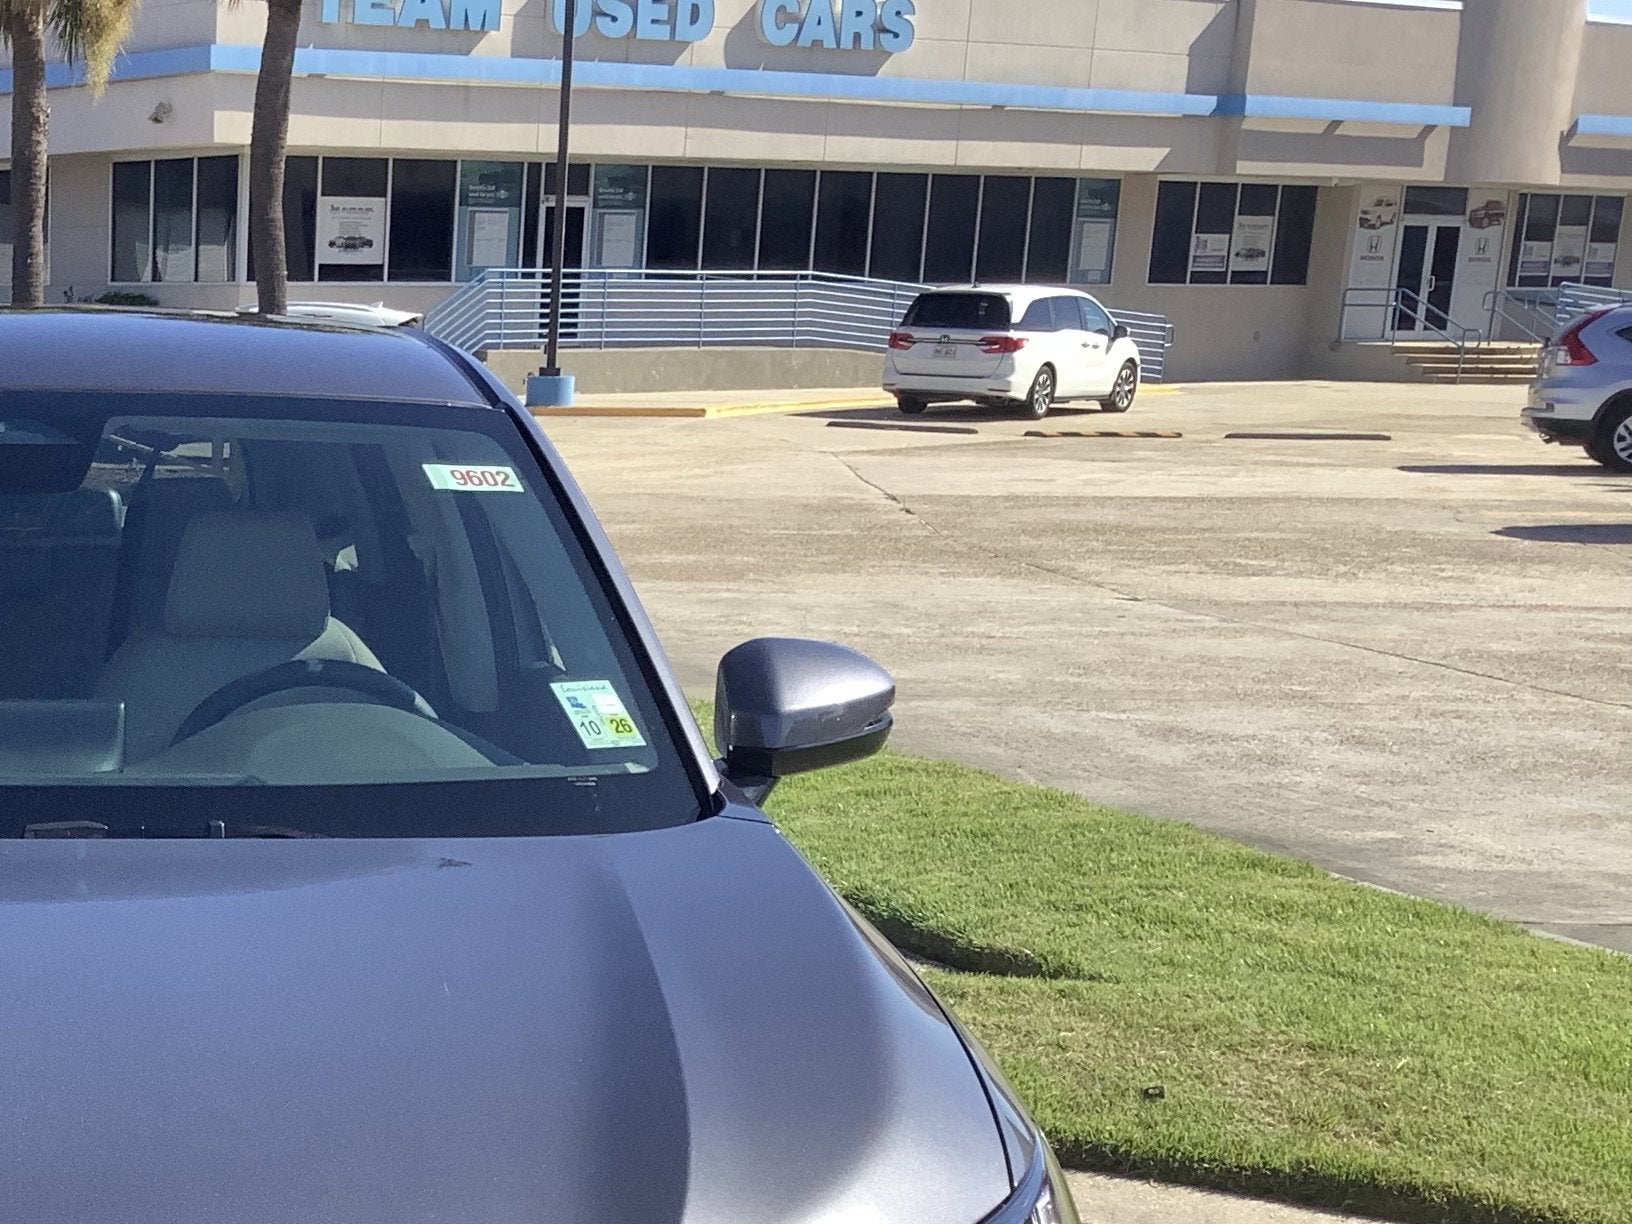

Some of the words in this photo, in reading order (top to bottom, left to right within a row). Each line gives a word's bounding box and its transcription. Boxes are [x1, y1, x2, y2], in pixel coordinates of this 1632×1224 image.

[552, 0, 715, 42] USED
[760, 0, 915, 53] CARS
[450, 469, 515, 487] 9602
[560, 684, 608, 693] Louisiana
[580, 720, 601, 736] 10
[610, 718, 632, 733] 26
